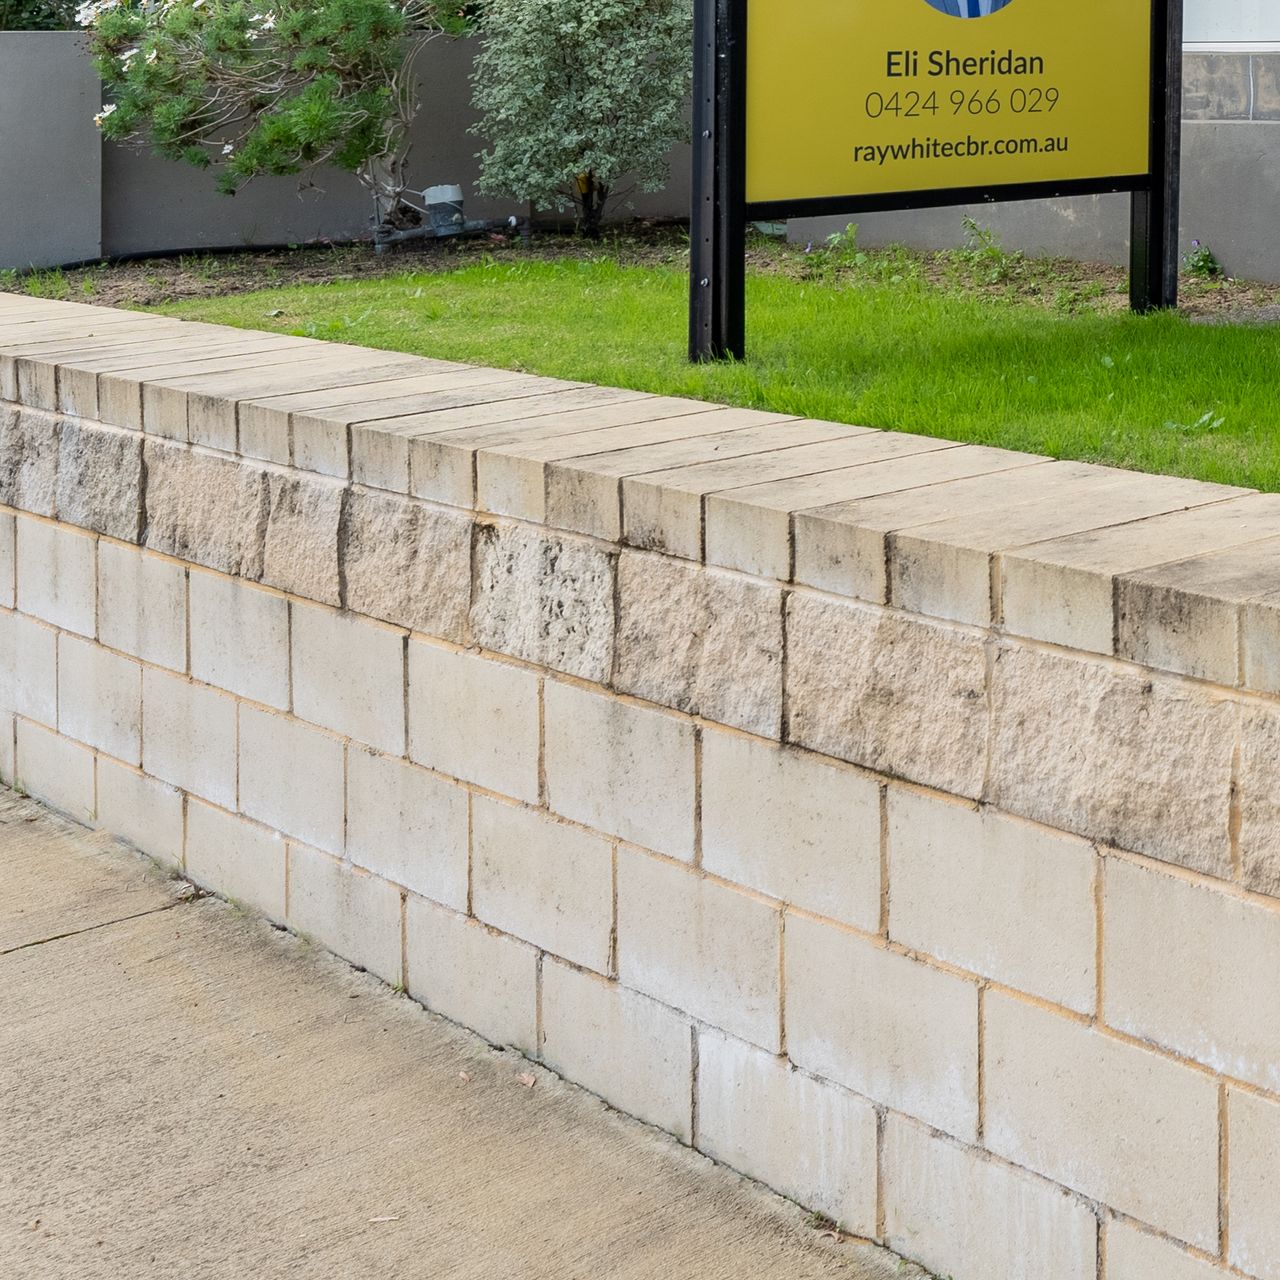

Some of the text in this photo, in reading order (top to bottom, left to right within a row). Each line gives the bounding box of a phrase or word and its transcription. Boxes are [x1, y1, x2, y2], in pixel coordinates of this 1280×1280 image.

[886, 49, 1044, 77] Eli Sheridan
[865, 87, 1060, 118] 0424 966 029
[853, 135, 1069, 166] raywhitecbr.com.au
